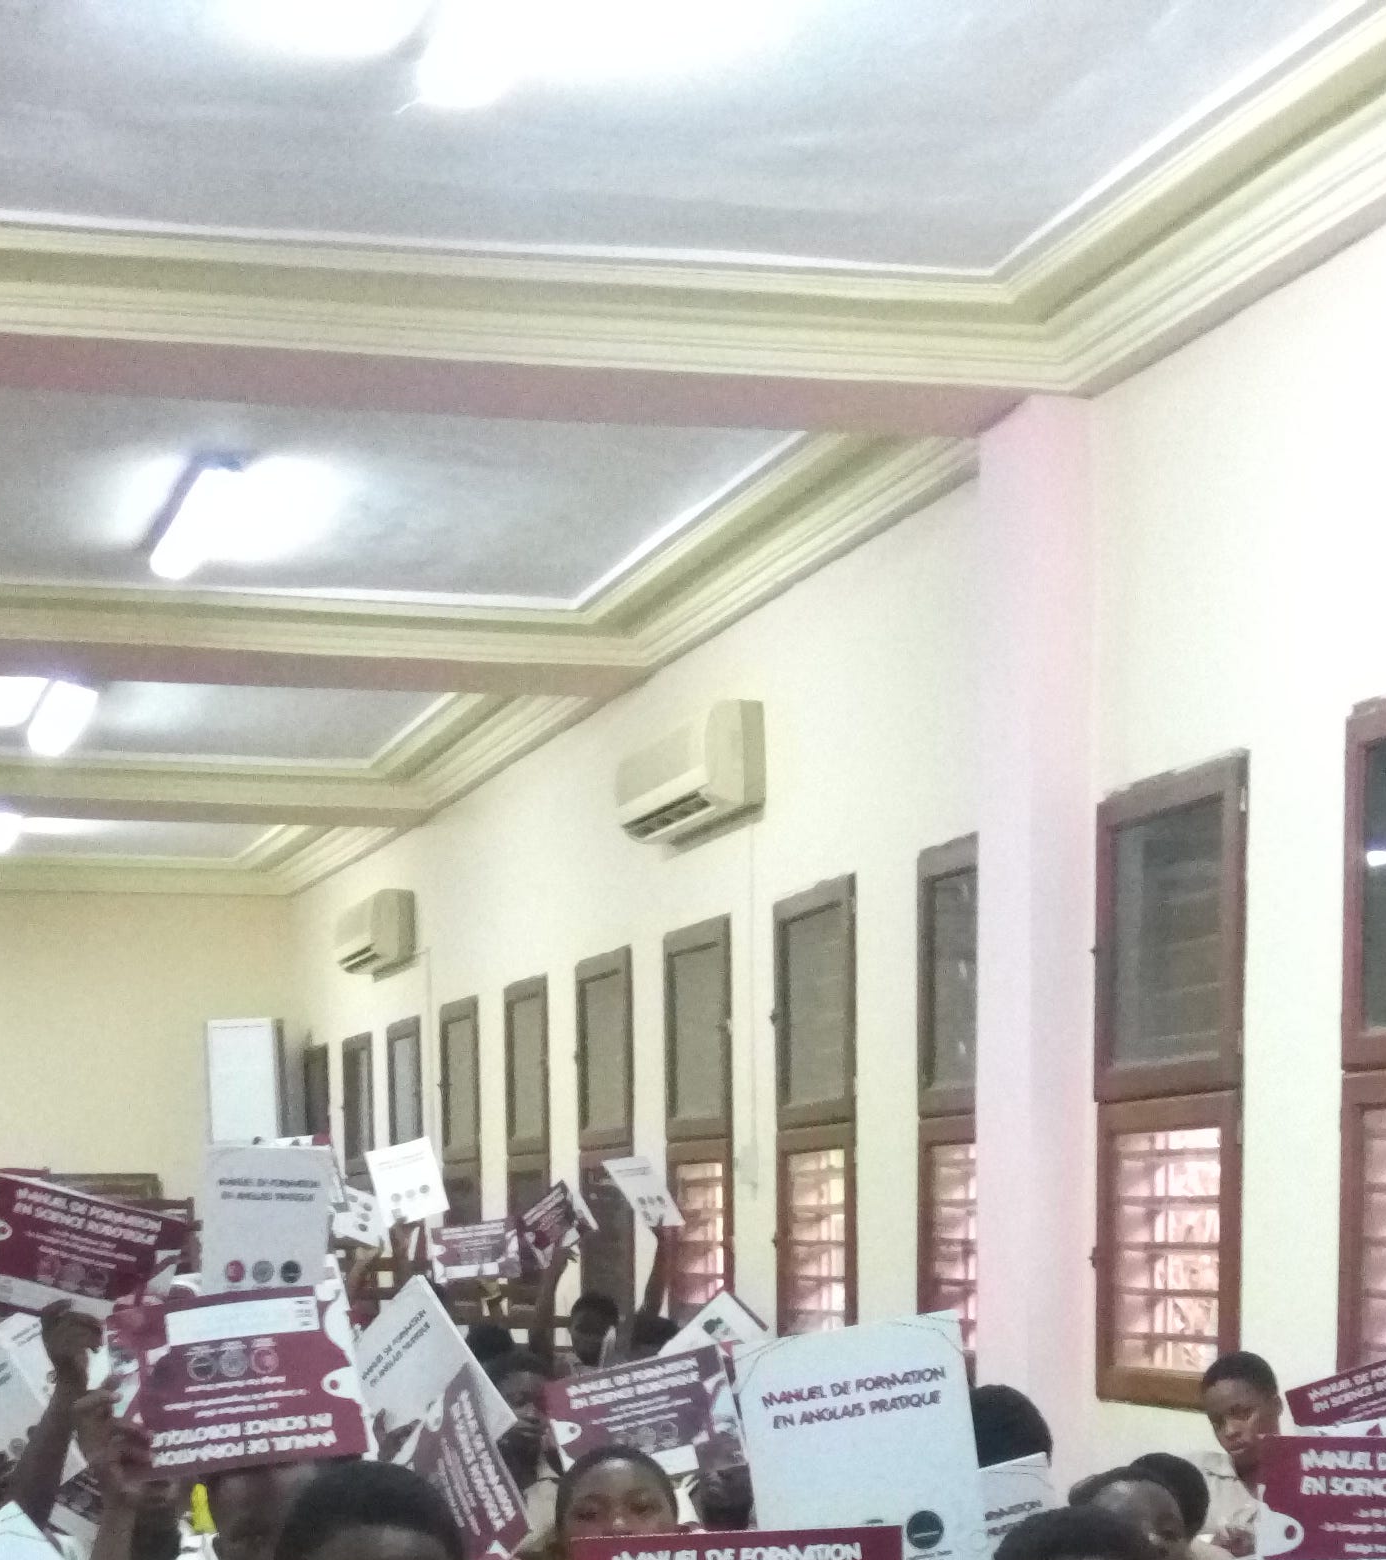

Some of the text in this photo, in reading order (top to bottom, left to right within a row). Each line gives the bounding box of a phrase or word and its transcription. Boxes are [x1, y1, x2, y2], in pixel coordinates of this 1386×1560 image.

[760, 1366, 945, 1408] MANUEL DE FORMATION
[772, 1389, 940, 1429] EN ANGLAIS PRATIQUE
[1299, 1448, 1373, 1471] MANUEL
[1299, 1475, 1326, 1495] EN
